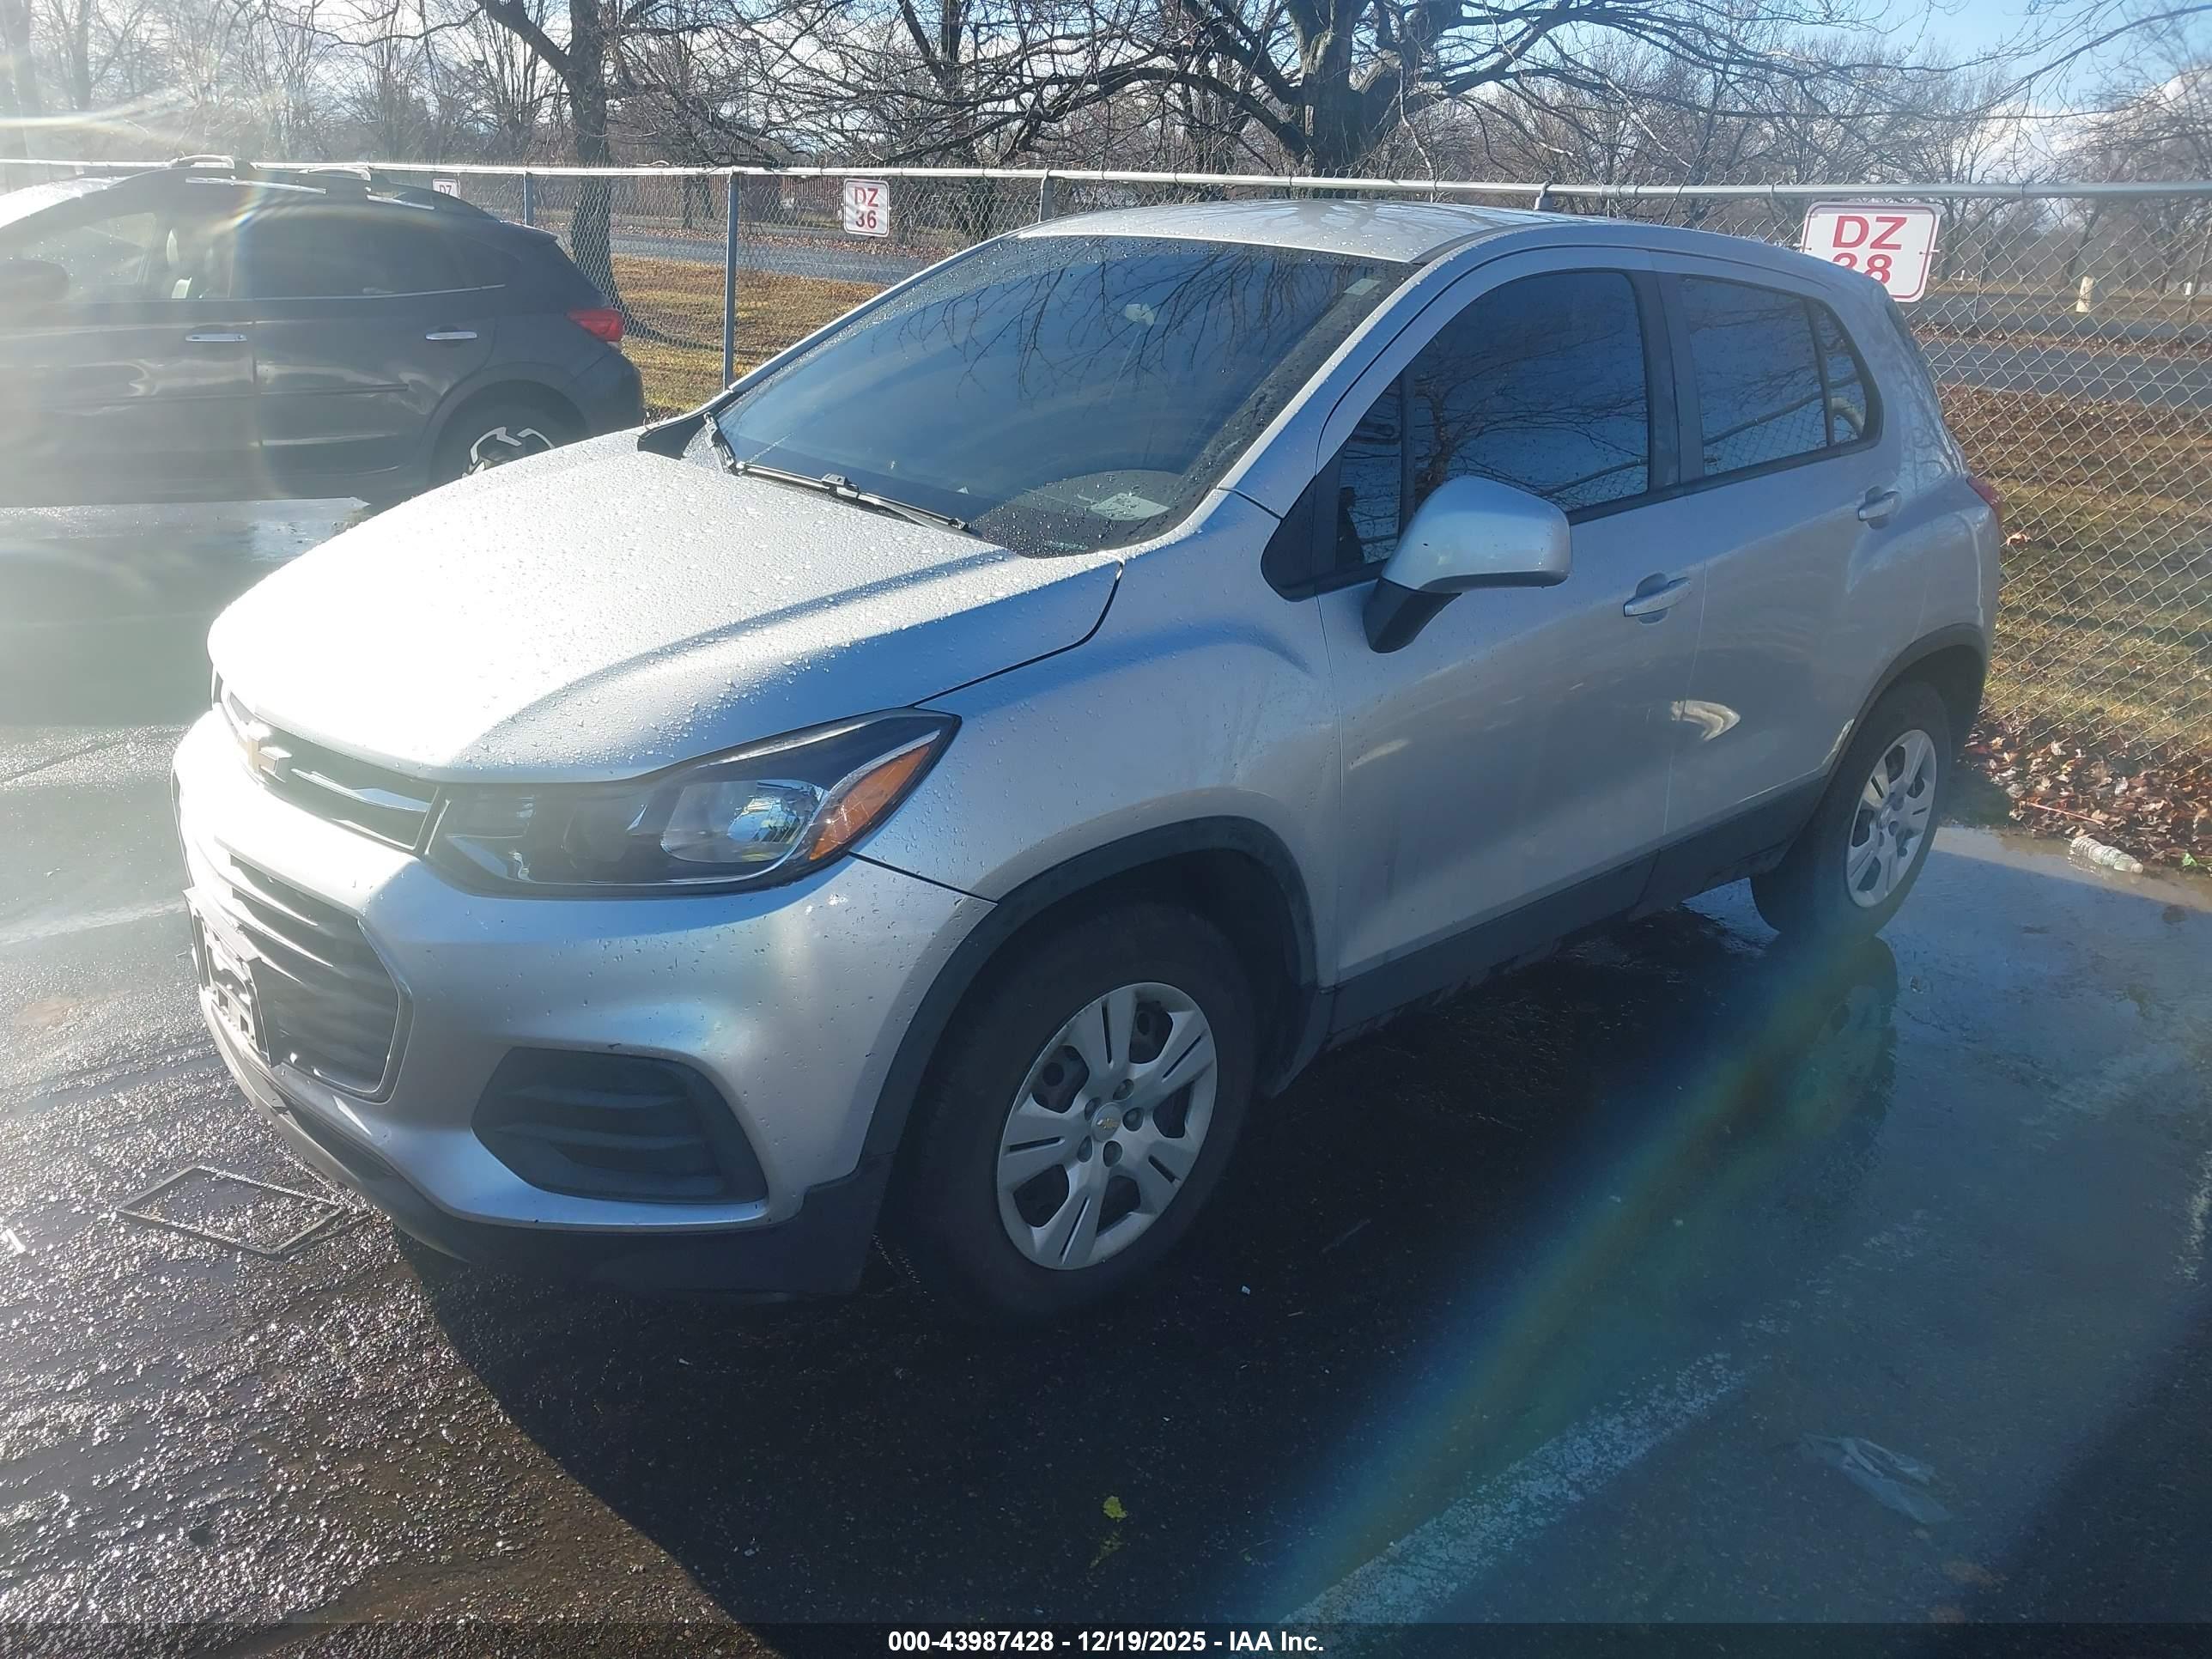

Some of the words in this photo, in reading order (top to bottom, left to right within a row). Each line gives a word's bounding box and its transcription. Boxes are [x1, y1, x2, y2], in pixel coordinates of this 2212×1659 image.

[854, 186, 879, 207] DZ
[855, 210, 878, 229] 36
[1832, 216, 1909, 251] DZ
